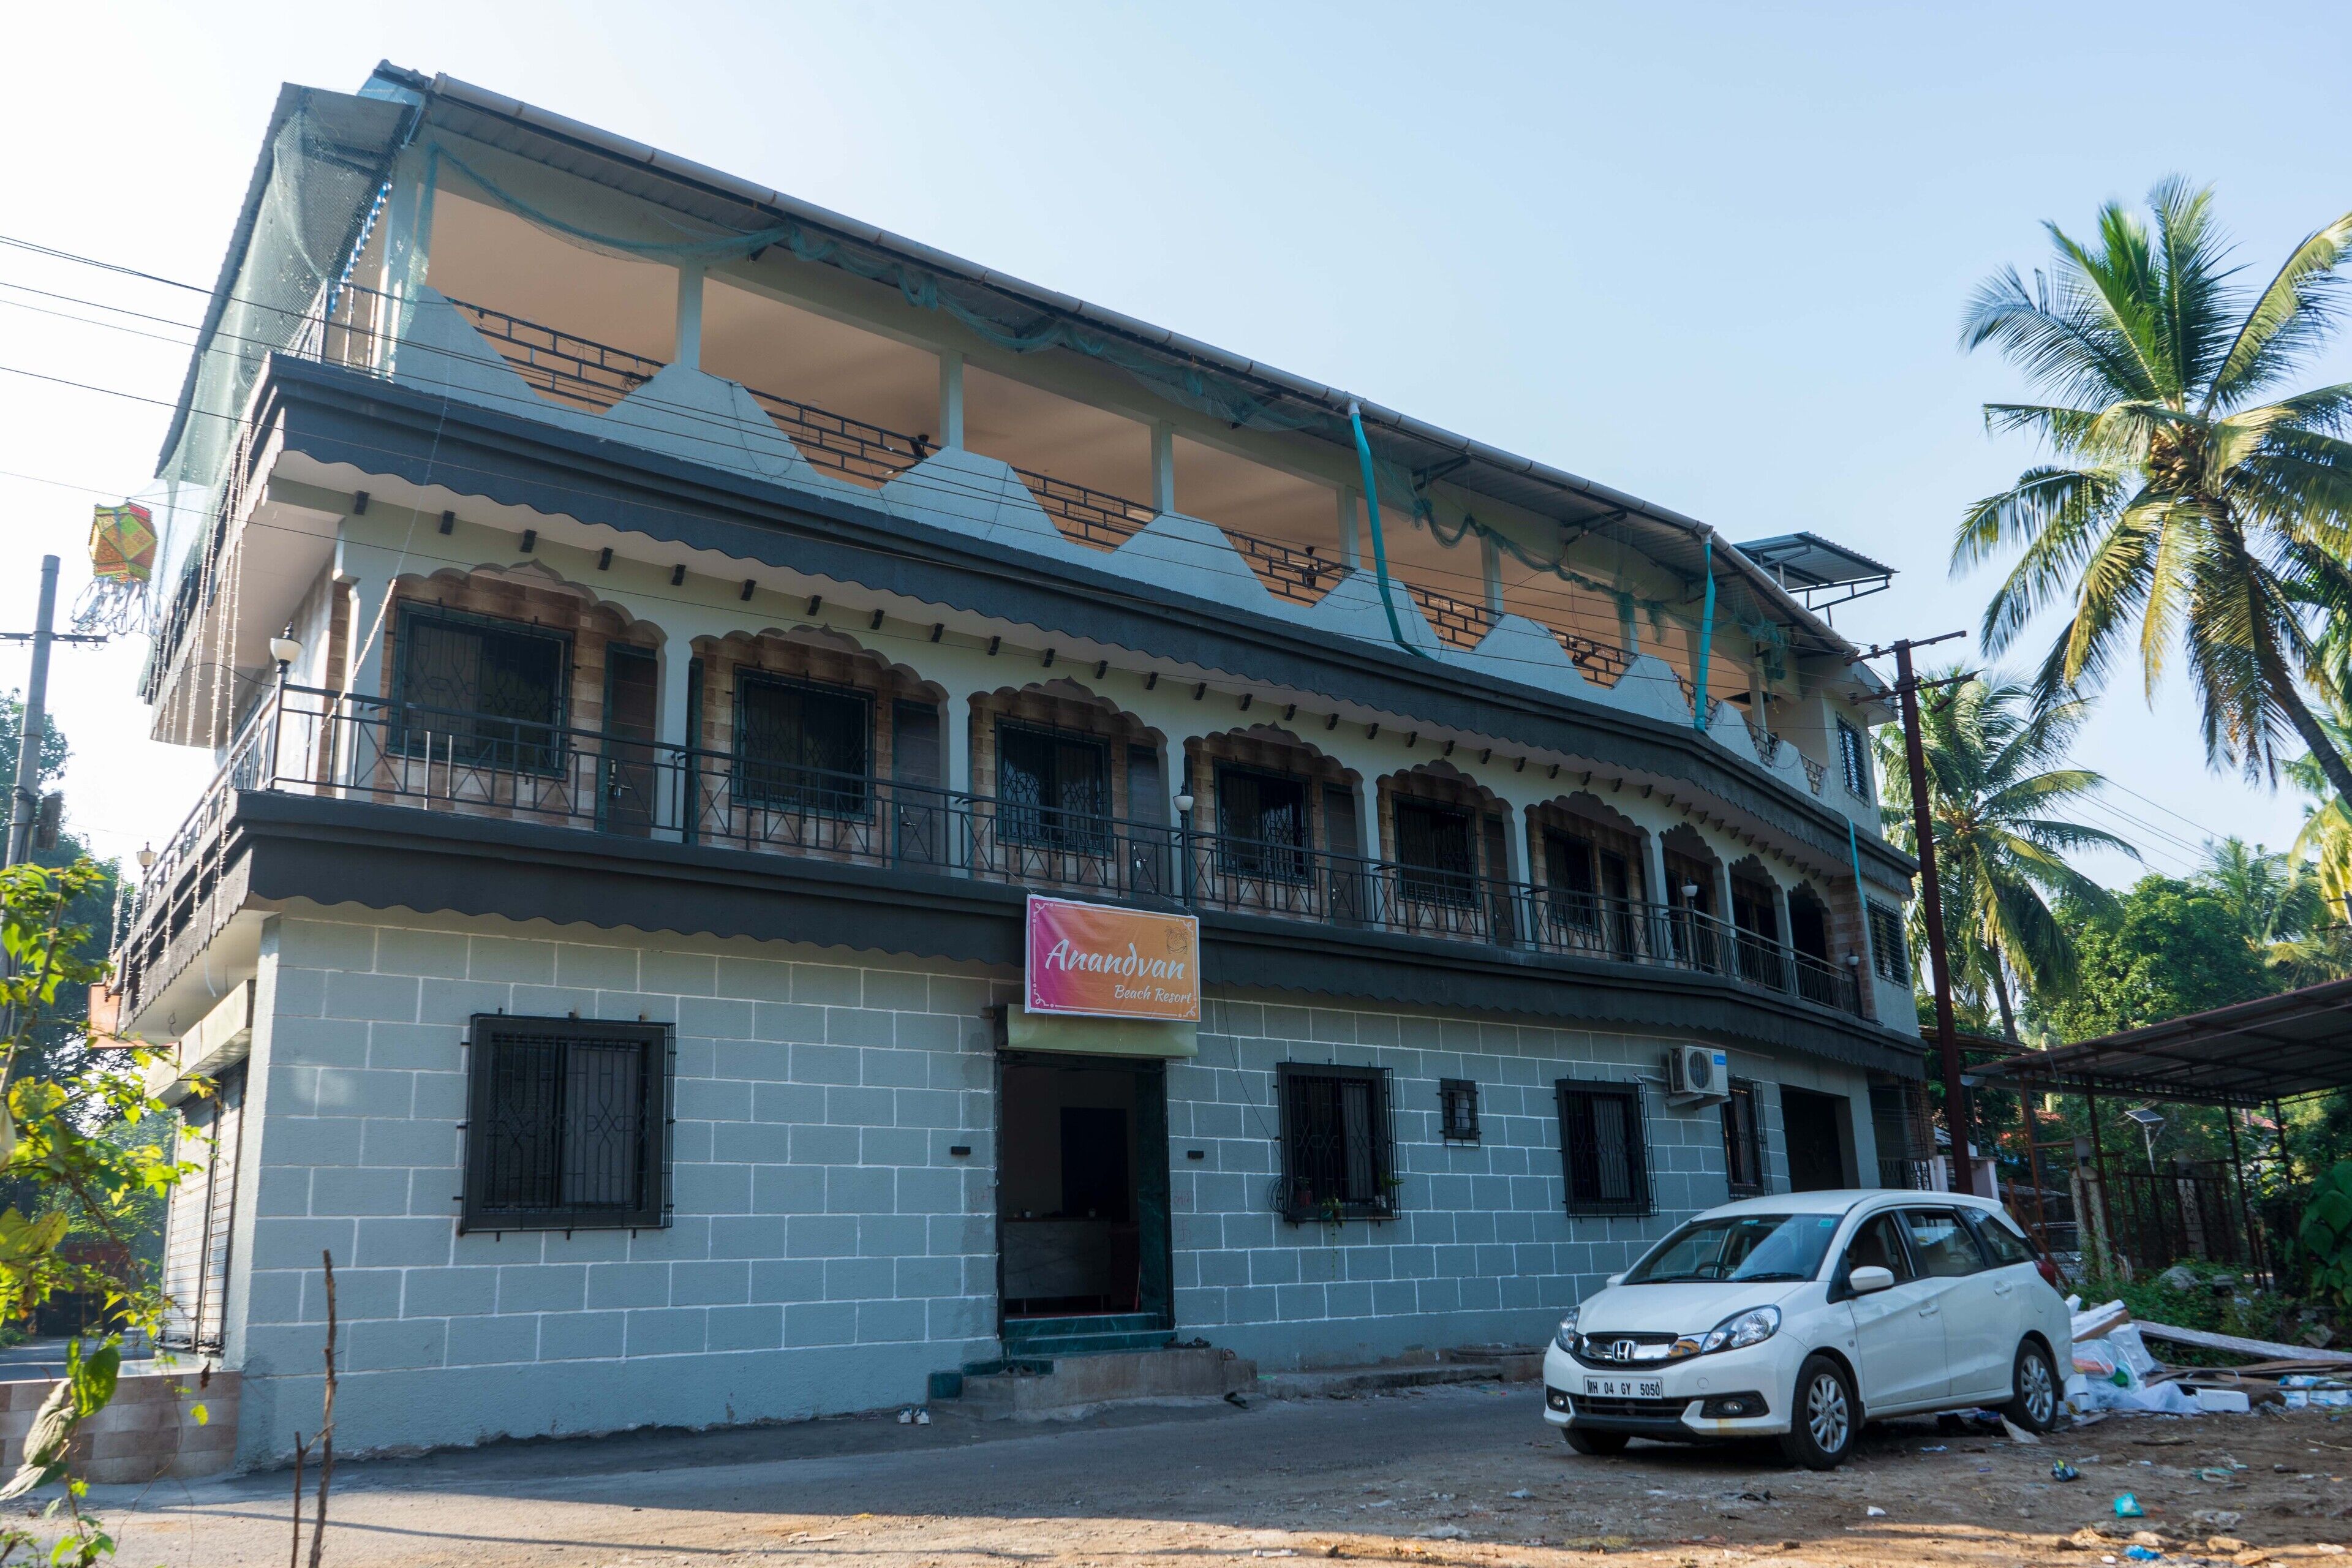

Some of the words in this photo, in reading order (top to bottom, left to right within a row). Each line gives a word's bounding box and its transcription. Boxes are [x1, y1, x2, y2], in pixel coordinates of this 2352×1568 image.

[1045, 939, 1185, 980] Anandvan
[1114, 984, 1151, 1000] Beach
[1155, 987, 1193, 1003] Resort
[1587, 1380, 1599, 1394] MH
[1604, 1382, 1614, 1395] 04
[1621, 1382, 1630, 1395] GY
[1640, 1382, 1660, 1396] 5050
